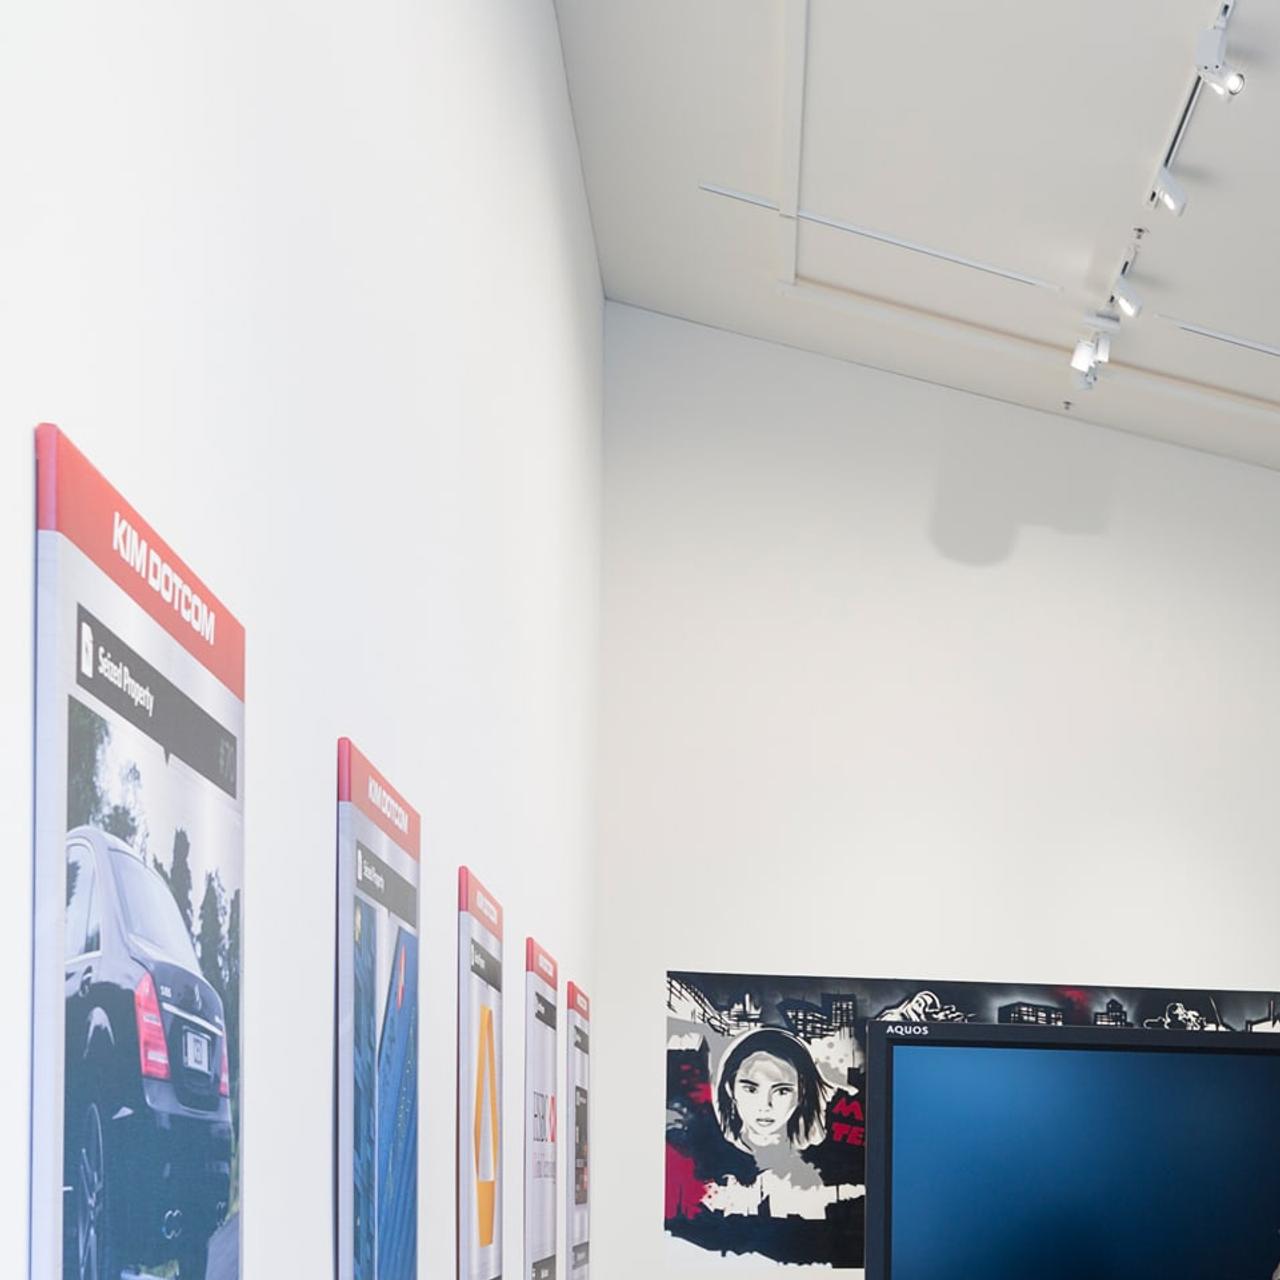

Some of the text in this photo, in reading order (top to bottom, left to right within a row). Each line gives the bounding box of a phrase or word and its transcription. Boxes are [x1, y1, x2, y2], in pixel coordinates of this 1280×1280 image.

[112, 511, 216, 646] KIM DOTCOM
[98, 646, 155, 717] Seized Property
[886, 1025, 929, 1036] AQUOS
